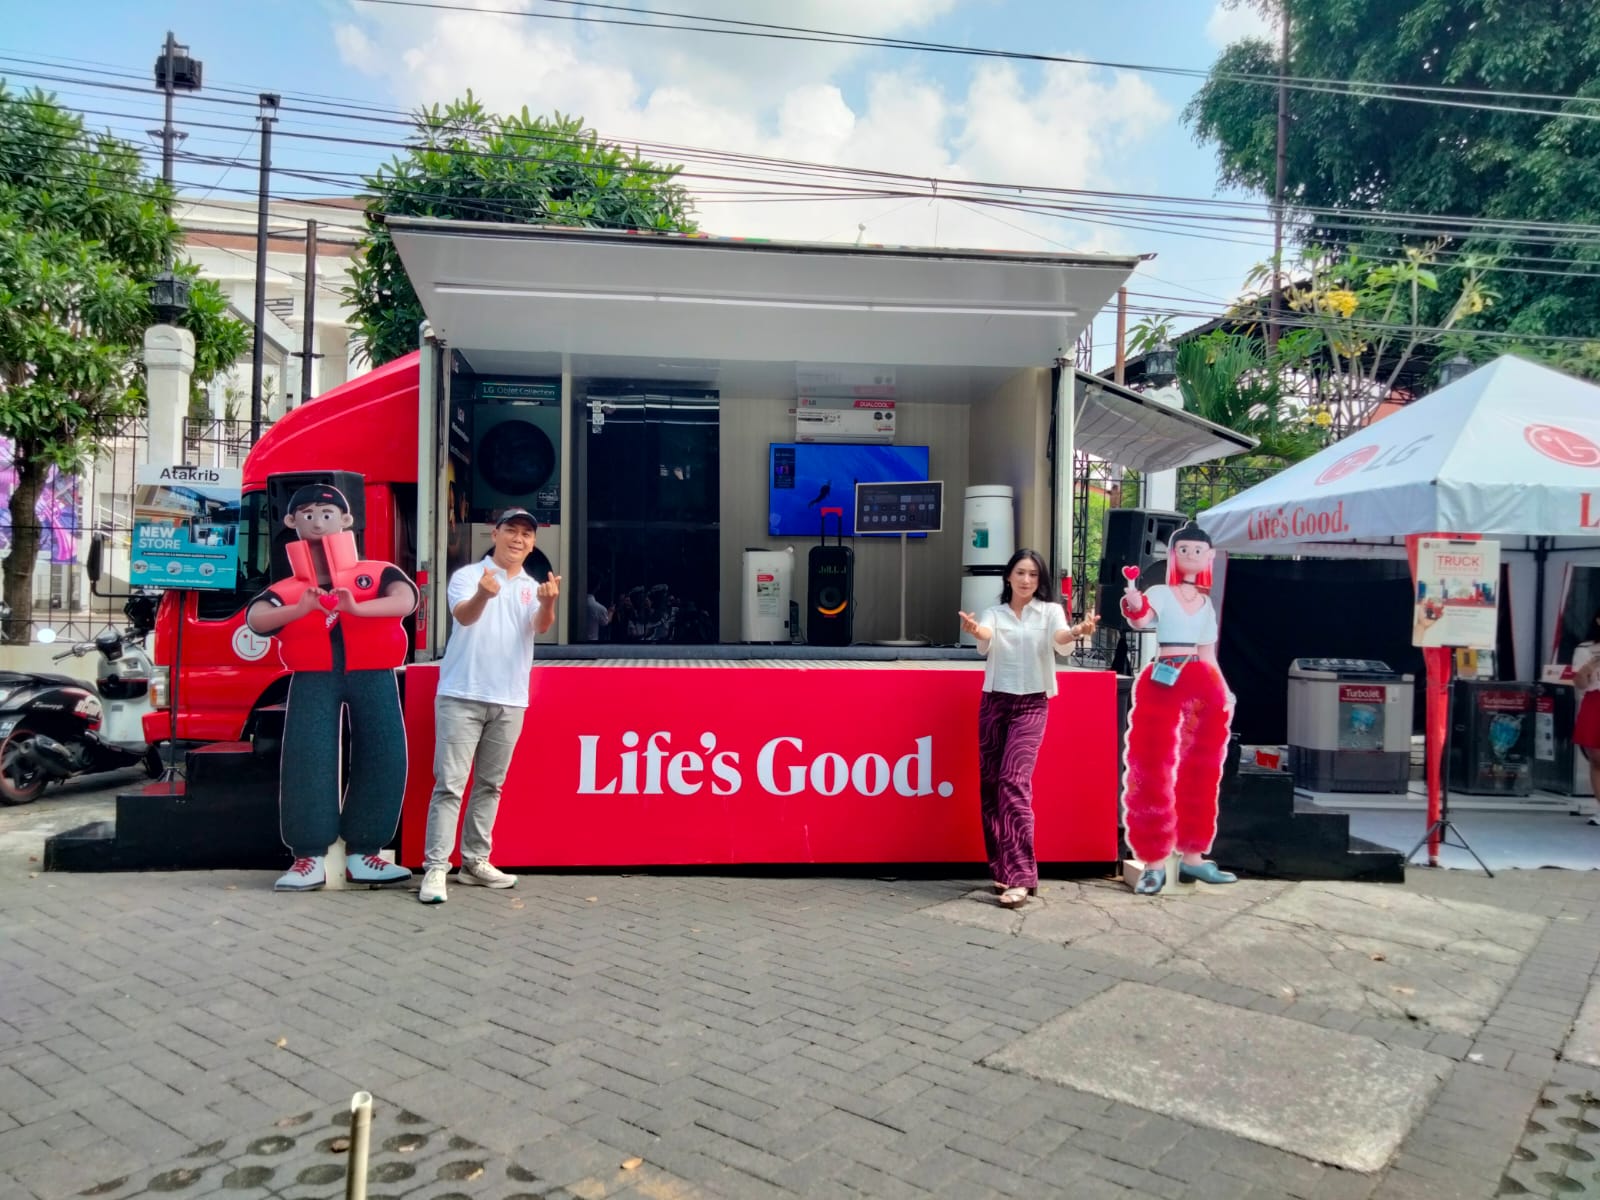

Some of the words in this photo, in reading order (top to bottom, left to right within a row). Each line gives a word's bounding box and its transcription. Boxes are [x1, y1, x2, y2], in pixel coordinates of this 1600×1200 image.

[1360, 434, 1435, 473] LG
[160, 468, 220, 481] Atakrib
[1292, 500, 1349, 537] Good.
[140, 526, 176, 539] NEW
[138, 538, 180, 550] STORE
[1437, 555, 1480, 567] TRUCK
[576, 730, 742, 796] Life's
[756, 735, 954, 798] Good.
